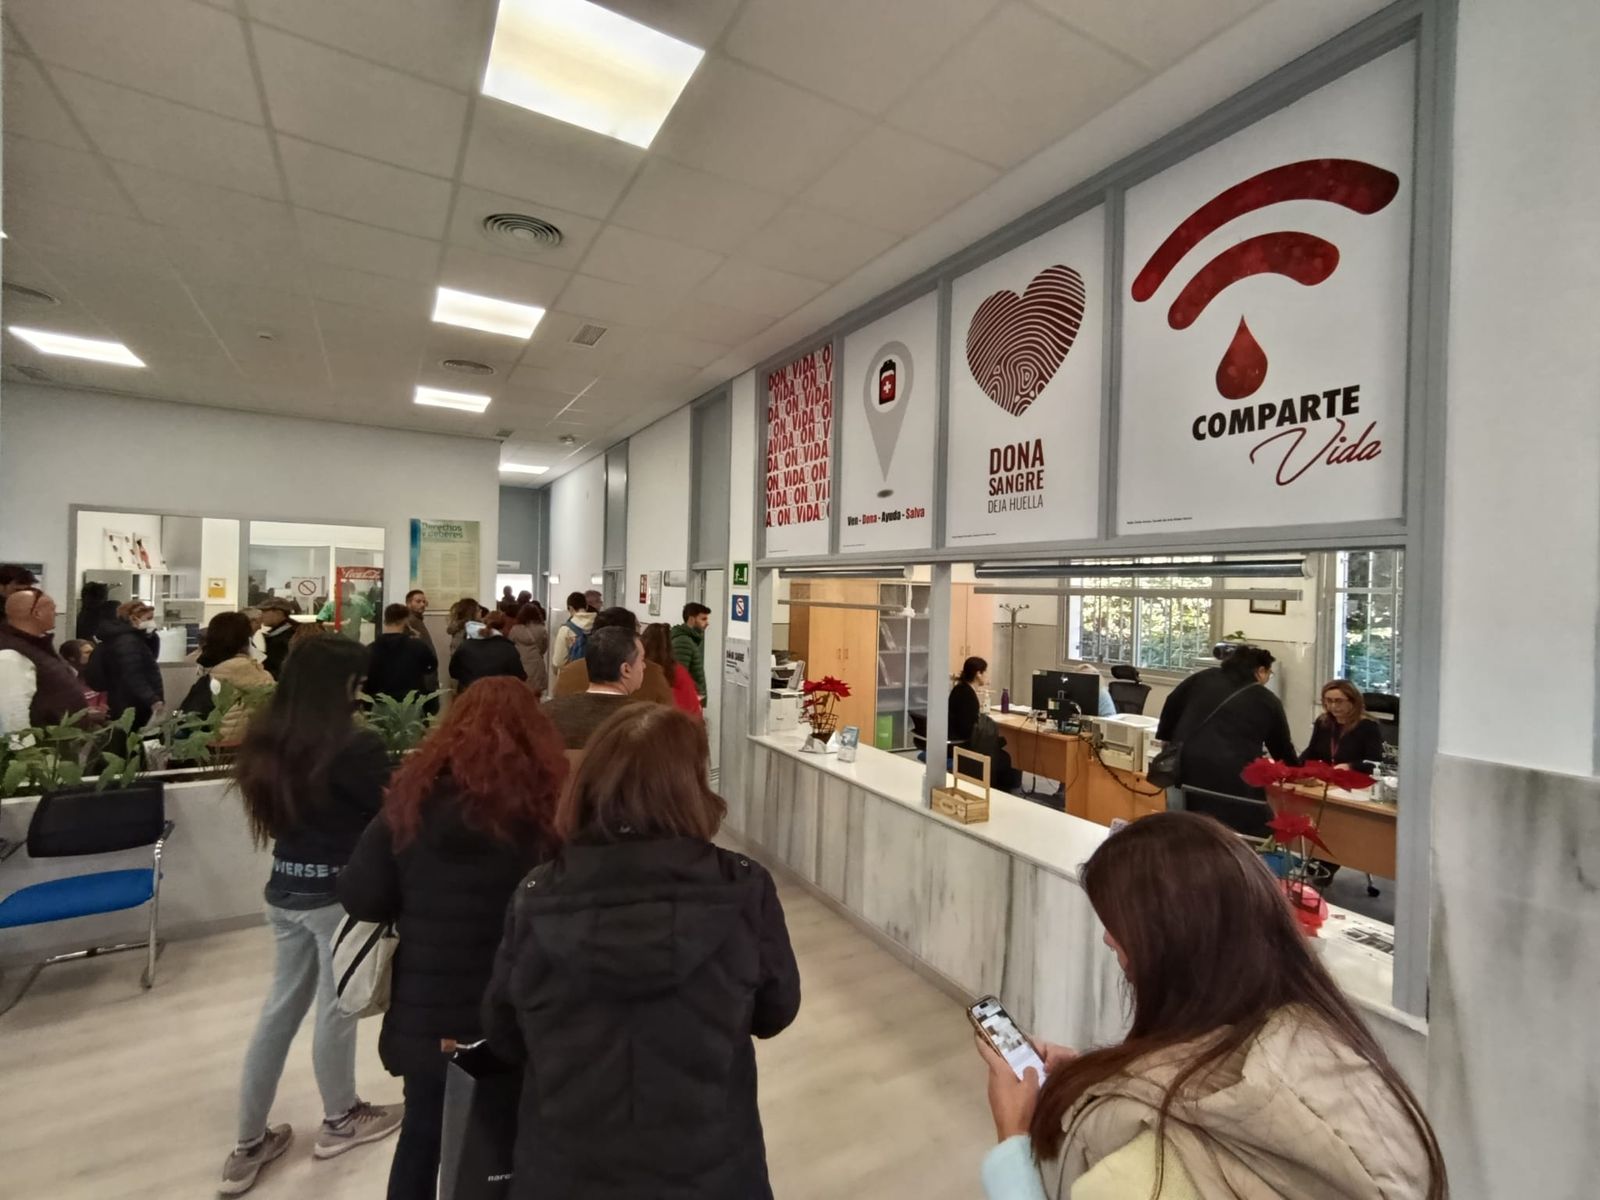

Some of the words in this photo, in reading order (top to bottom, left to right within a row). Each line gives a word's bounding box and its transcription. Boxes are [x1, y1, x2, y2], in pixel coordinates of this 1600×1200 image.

[774, 380, 795, 404] VIDA
[792, 407, 815, 431] VIDA
[1192, 384, 1360, 441] COMPARTE
[803, 440, 829, 463] VIDA
[989, 438, 1045, 475] DONA
[1249, 418, 1382, 486] Vida
[783, 467, 805, 488] VIDA
[988, 469, 1045, 497] SANGRE
[767, 490, 788, 510] VIDA
[987, 498, 1008, 514] DEJA
[1010, 493, 1044, 512] HUELLA
[796, 502, 821, 523] VIDA
[847, 516, 859, 526] Ven
[862, 514, 877, 524] Dona
[881, 510, 901, 523] Ayuda
[906, 507, 925, 519] Salva
